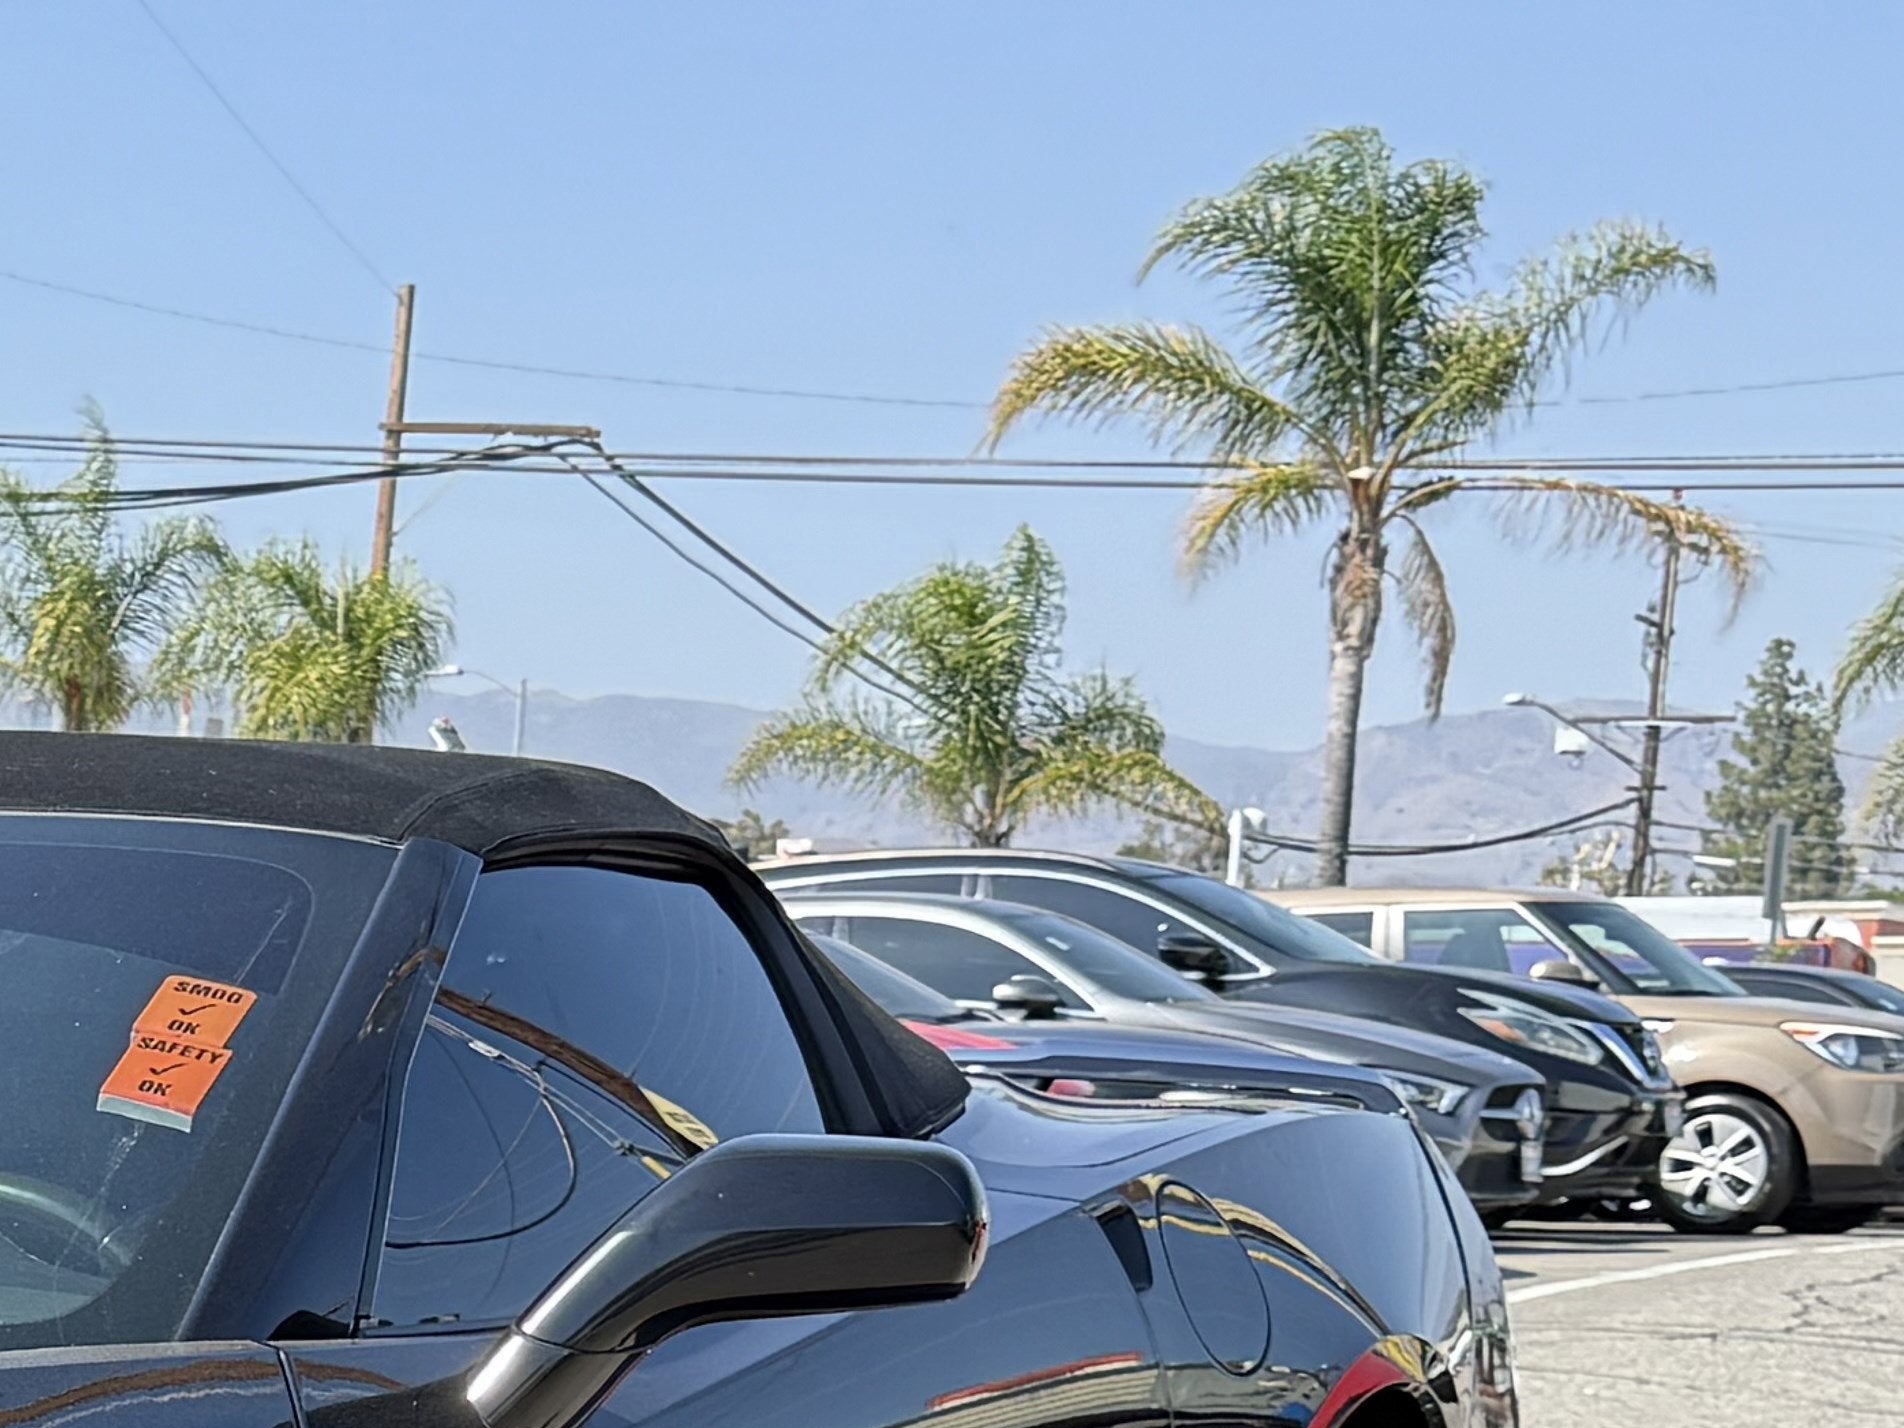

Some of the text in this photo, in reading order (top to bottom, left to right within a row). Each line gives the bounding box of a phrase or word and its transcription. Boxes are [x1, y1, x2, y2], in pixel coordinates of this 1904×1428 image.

[168, 1019, 200, 1034] OK
[136, 1037, 224, 1064] SAFETY
[138, 1080, 173, 1097] OK
